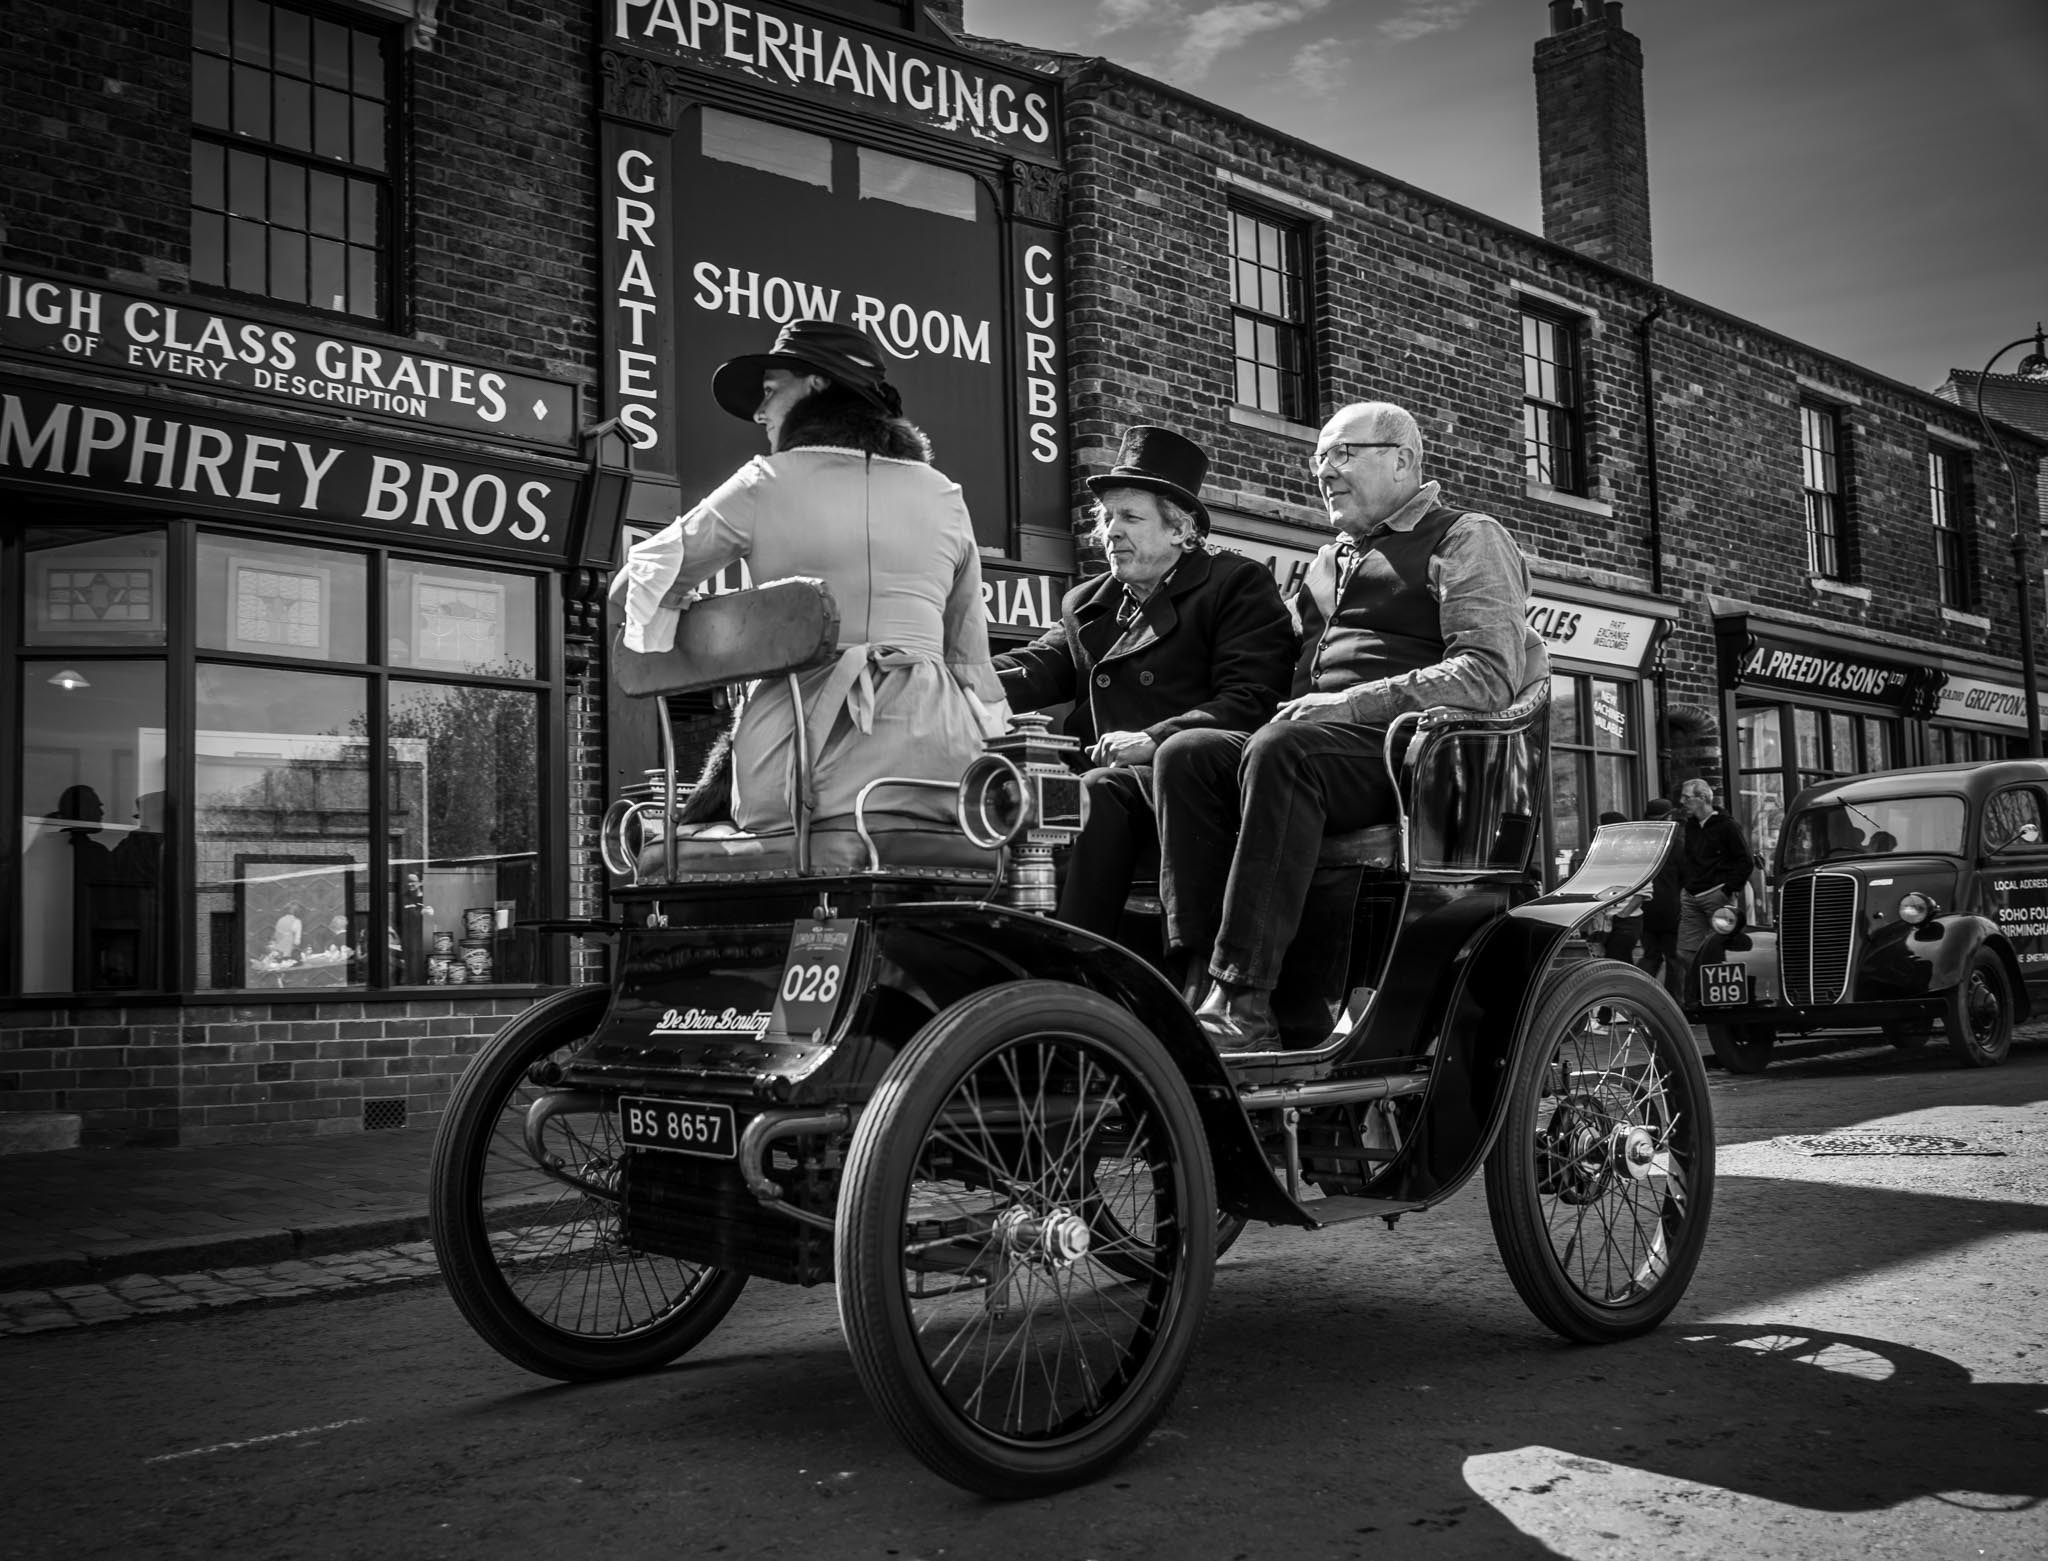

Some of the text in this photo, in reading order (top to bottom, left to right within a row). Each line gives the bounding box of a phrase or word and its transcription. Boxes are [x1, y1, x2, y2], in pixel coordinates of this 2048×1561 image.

[614, 0, 1050, 144] PAPERHANGINGS
[616, 149, 658, 450] GRATES
[693, 261, 991, 364] SHOW ROOM
[0, 273, 507, 423] IGH CLASS GRATES
[62, 333, 427, 418] OF EVERY DESCRIPTION
[1024, 244, 1058, 463] CURBS
[0, 393, 551, 543] MPHREY BROS.
[1993, 880, 2019, 891] LOCAL
[1999, 907, 2028, 922] SOHO
[782, 964, 840, 1003] 028
[1704, 966, 1744, 984] YHA
[1708, 985, 1742, 1003] 819
[630, 1108, 722, 1144] BS 8657
